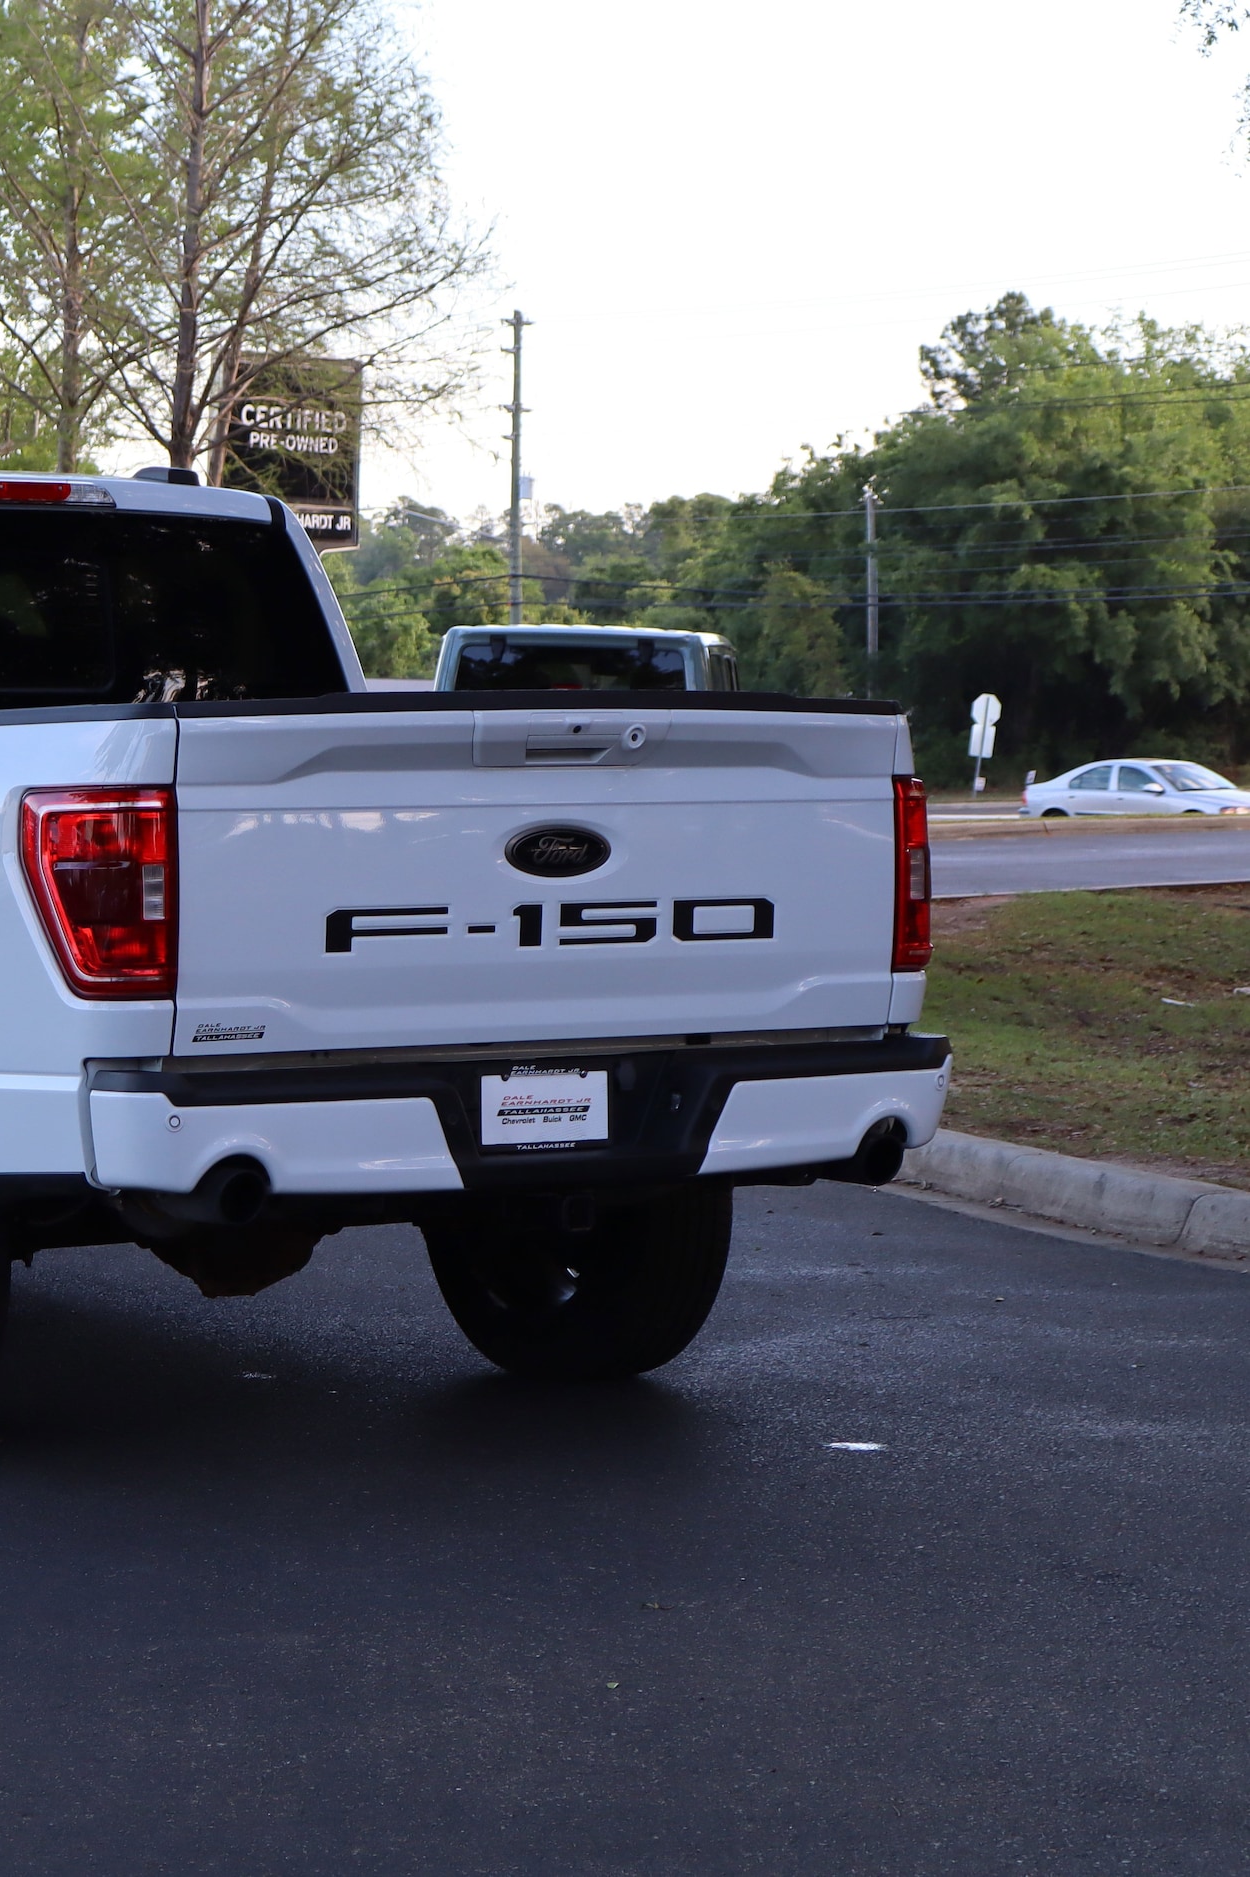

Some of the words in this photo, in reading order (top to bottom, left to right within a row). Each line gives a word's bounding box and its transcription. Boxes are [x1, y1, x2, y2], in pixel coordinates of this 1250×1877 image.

[241, 404, 347, 434] CERTIFIED
[249, 431, 339, 454] PRE-OWNED
[296, 513, 334, 529] HARDT
[335, 515, 351, 530] JR
[533, 836, 589, 864] Ford
[325, 897, 775, 953] F-150
[503, 1106, 585, 1115] TALLAHASSEE
[516, 1142, 576, 1150] TALLAHASSEE
